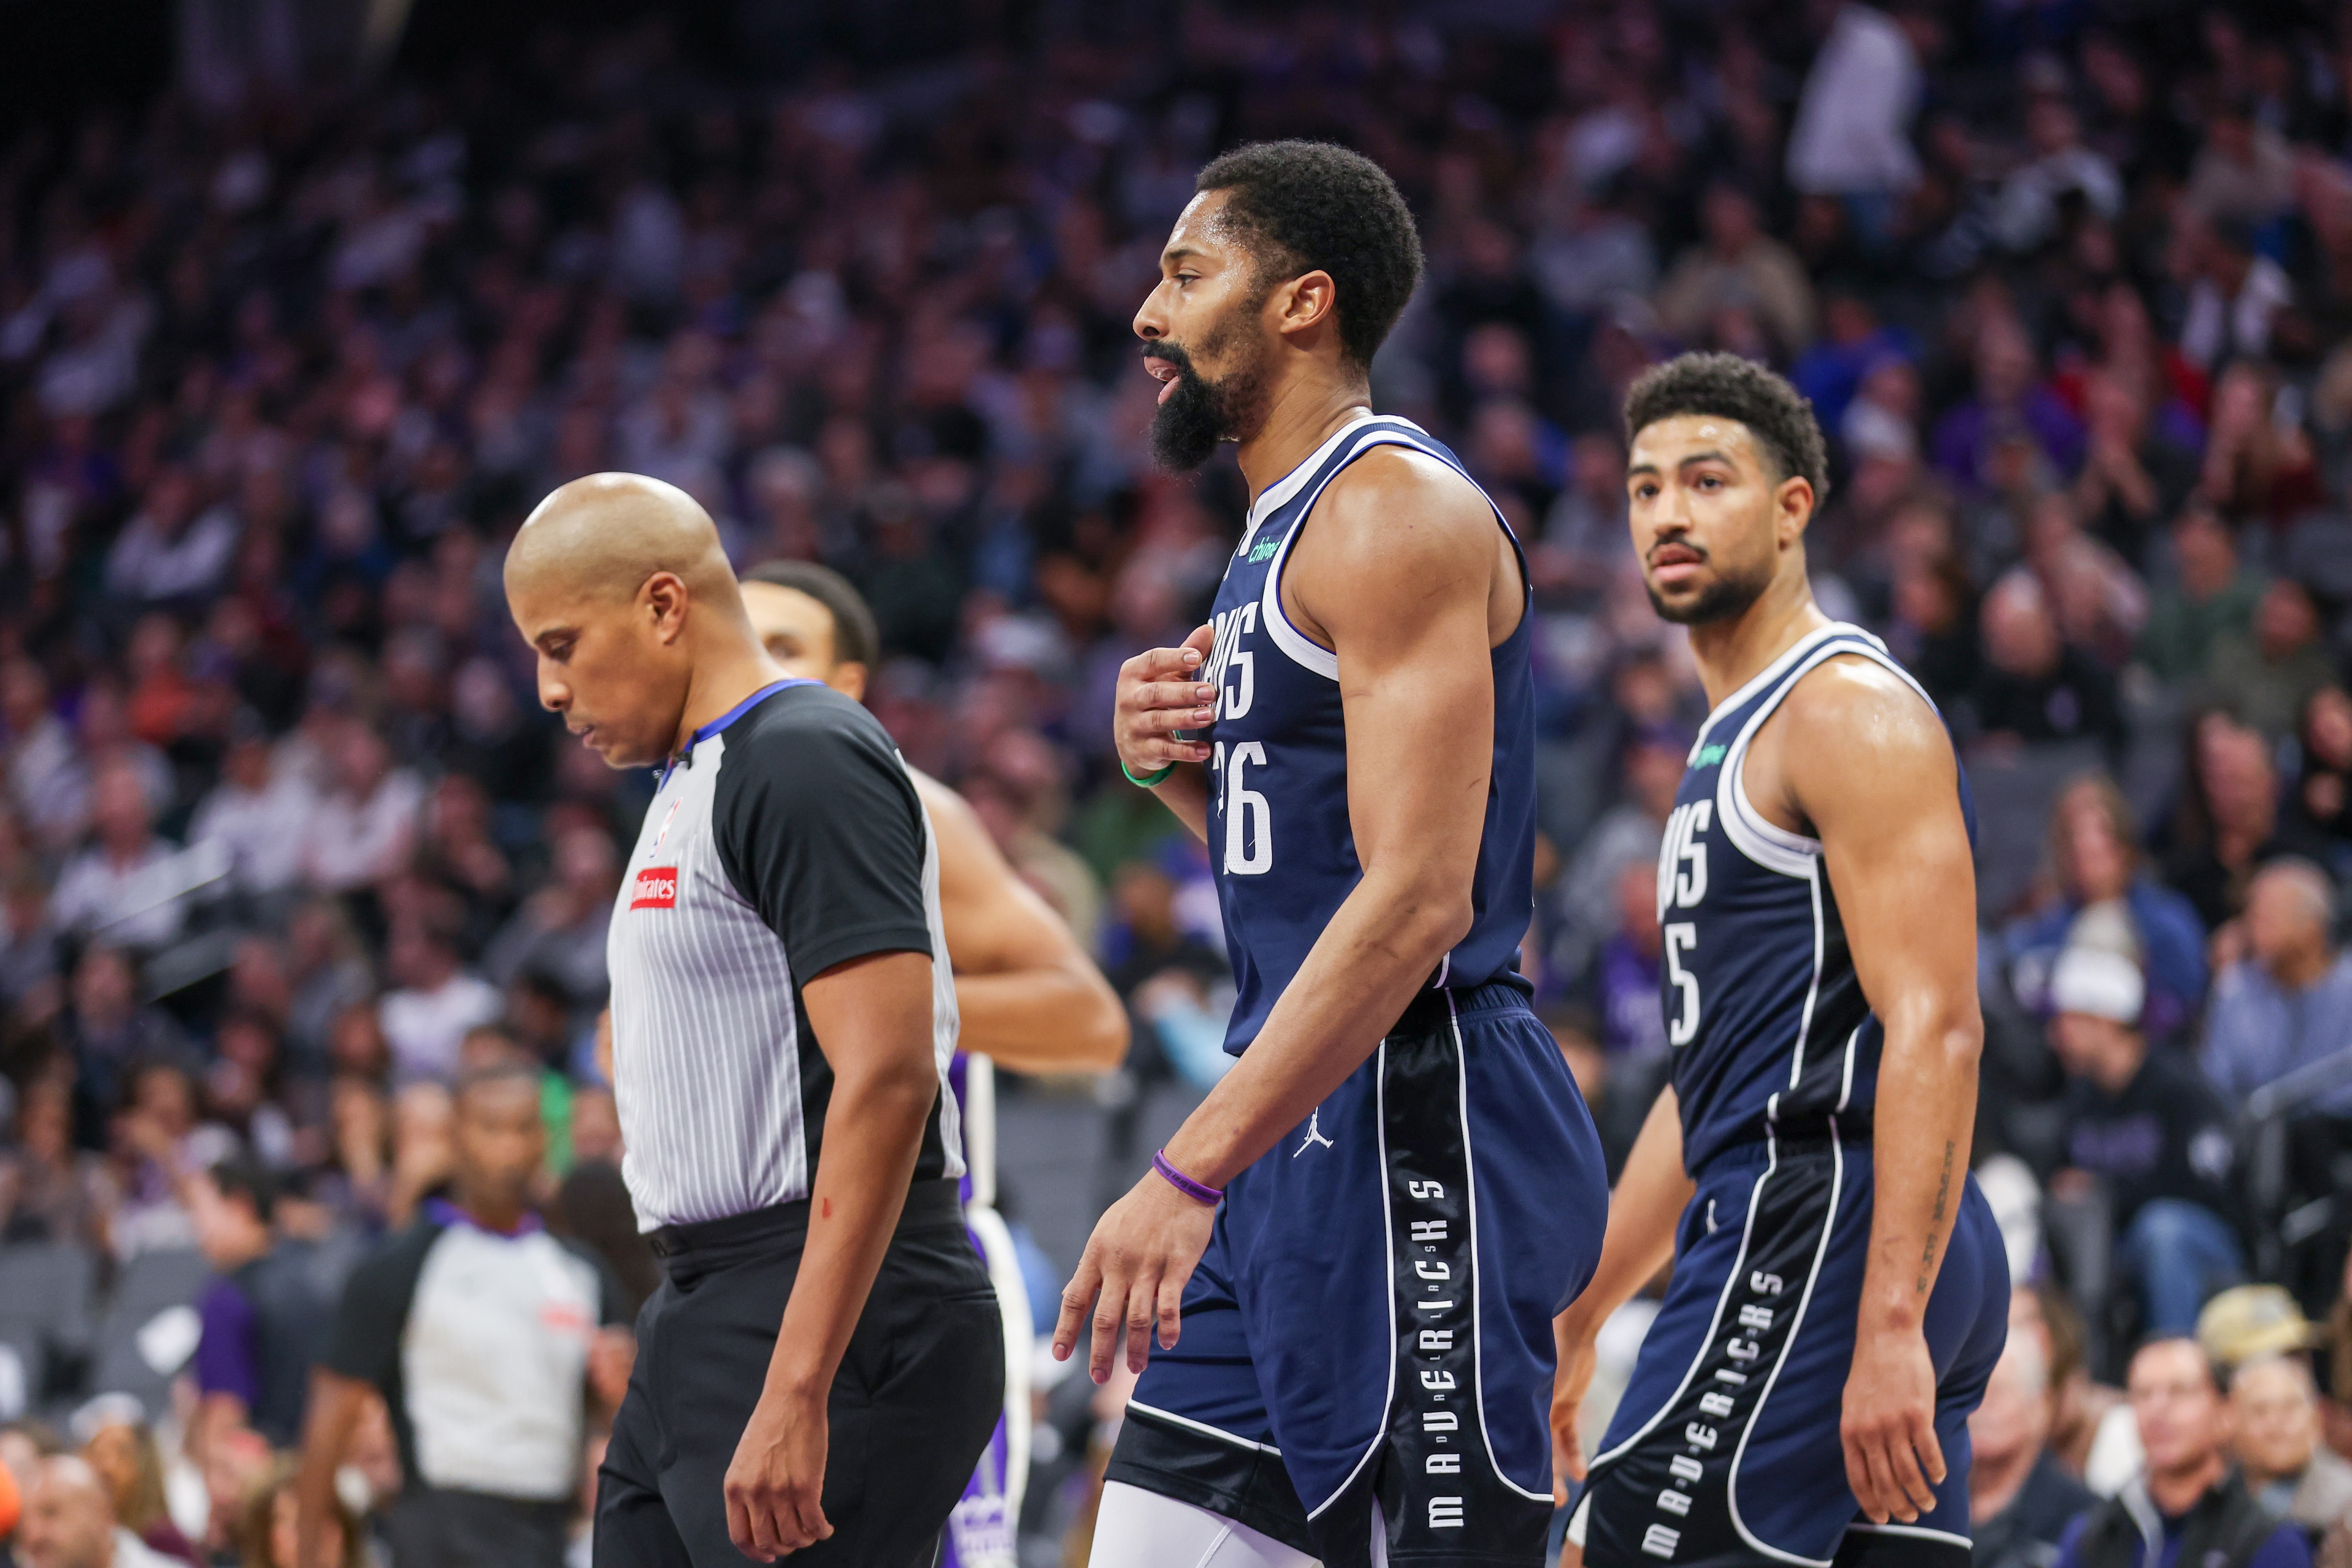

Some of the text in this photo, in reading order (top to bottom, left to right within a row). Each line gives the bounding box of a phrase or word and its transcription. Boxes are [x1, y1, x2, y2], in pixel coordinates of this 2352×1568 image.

[1248, 536, 1280, 563] chime
[1409, 1180, 1464, 1529] MAVERICKS
[1641, 1270, 1784, 1560] MAVERICKS
